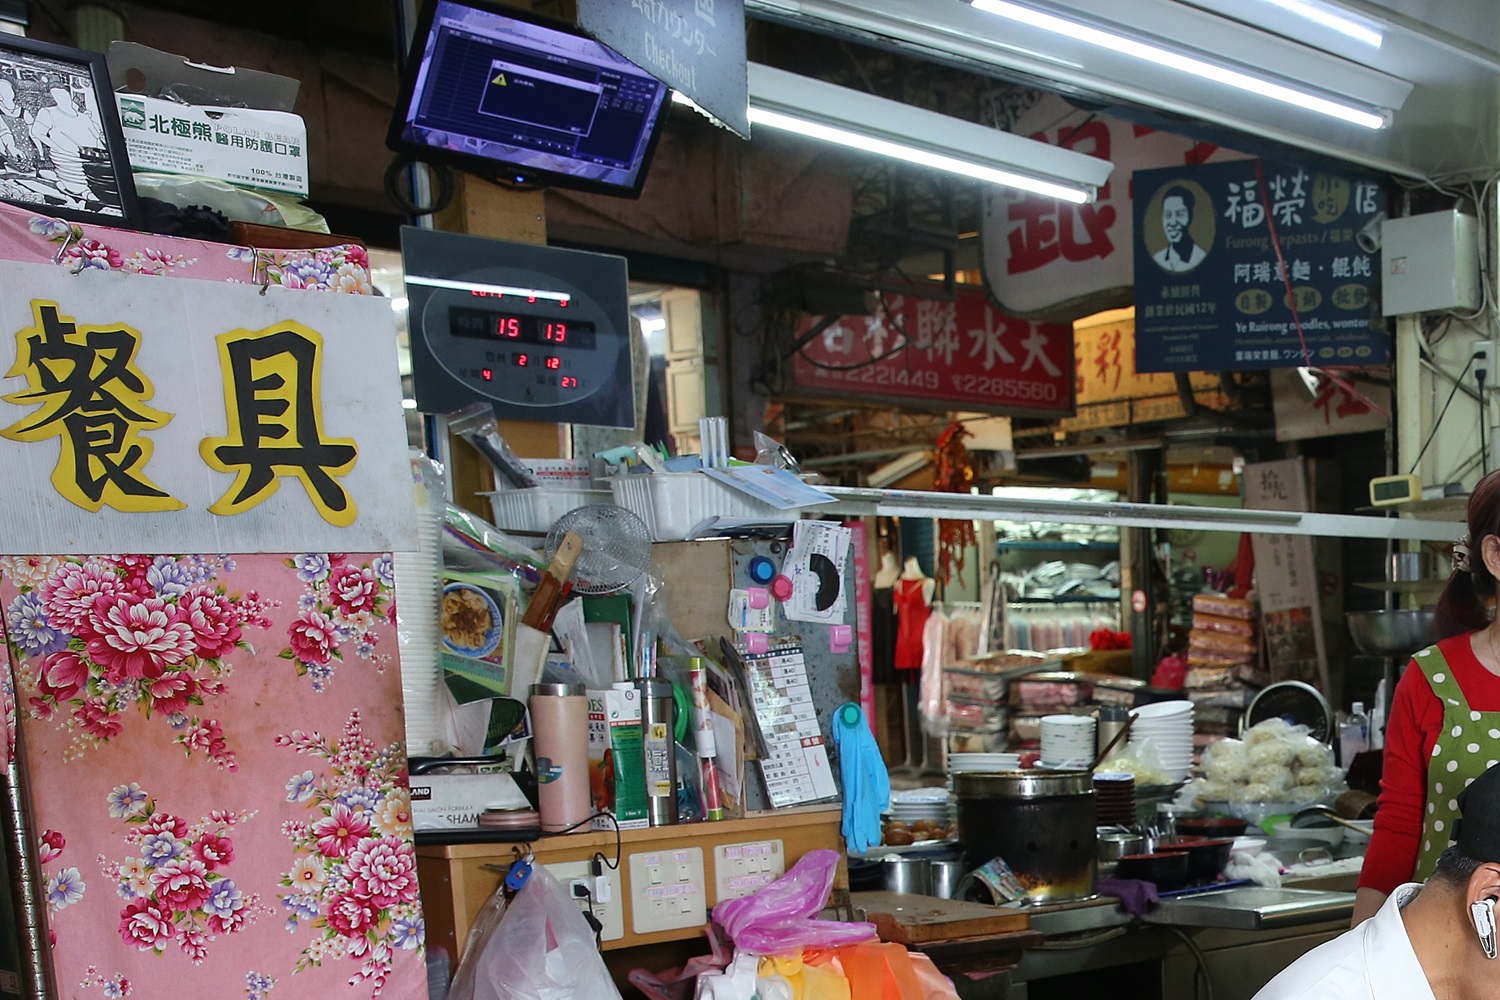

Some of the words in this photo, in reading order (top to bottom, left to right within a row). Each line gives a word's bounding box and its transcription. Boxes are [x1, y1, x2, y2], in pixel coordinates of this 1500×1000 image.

[645, 31, 697, 92] Checkout
[149, 113, 212, 143] 北極熊
[214, 122, 261, 139] POLAR
[265, 131, 301, 145] BEAR
[215, 131, 302, 157] 醫用防護口罩
[251, 168, 273, 177] 100%
[1224, 168, 1309, 229] 福榮
[1225, 236, 1269, 252] Furong
[1271, 232, 1319, 249] epasts
[498, 317, 521, 338] 15
[545, 323, 567, 343] 13
[1235, 321, 1248, 333] Ye
[518, 353, 528, 366] 2
[546, 356, 560, 370] 12
[482, 368, 492, 381] 4
[561, 376, 578, 389] 27
[5, 301, 358, 522] 餐具
[446, 813, 483, 825] SHAM
